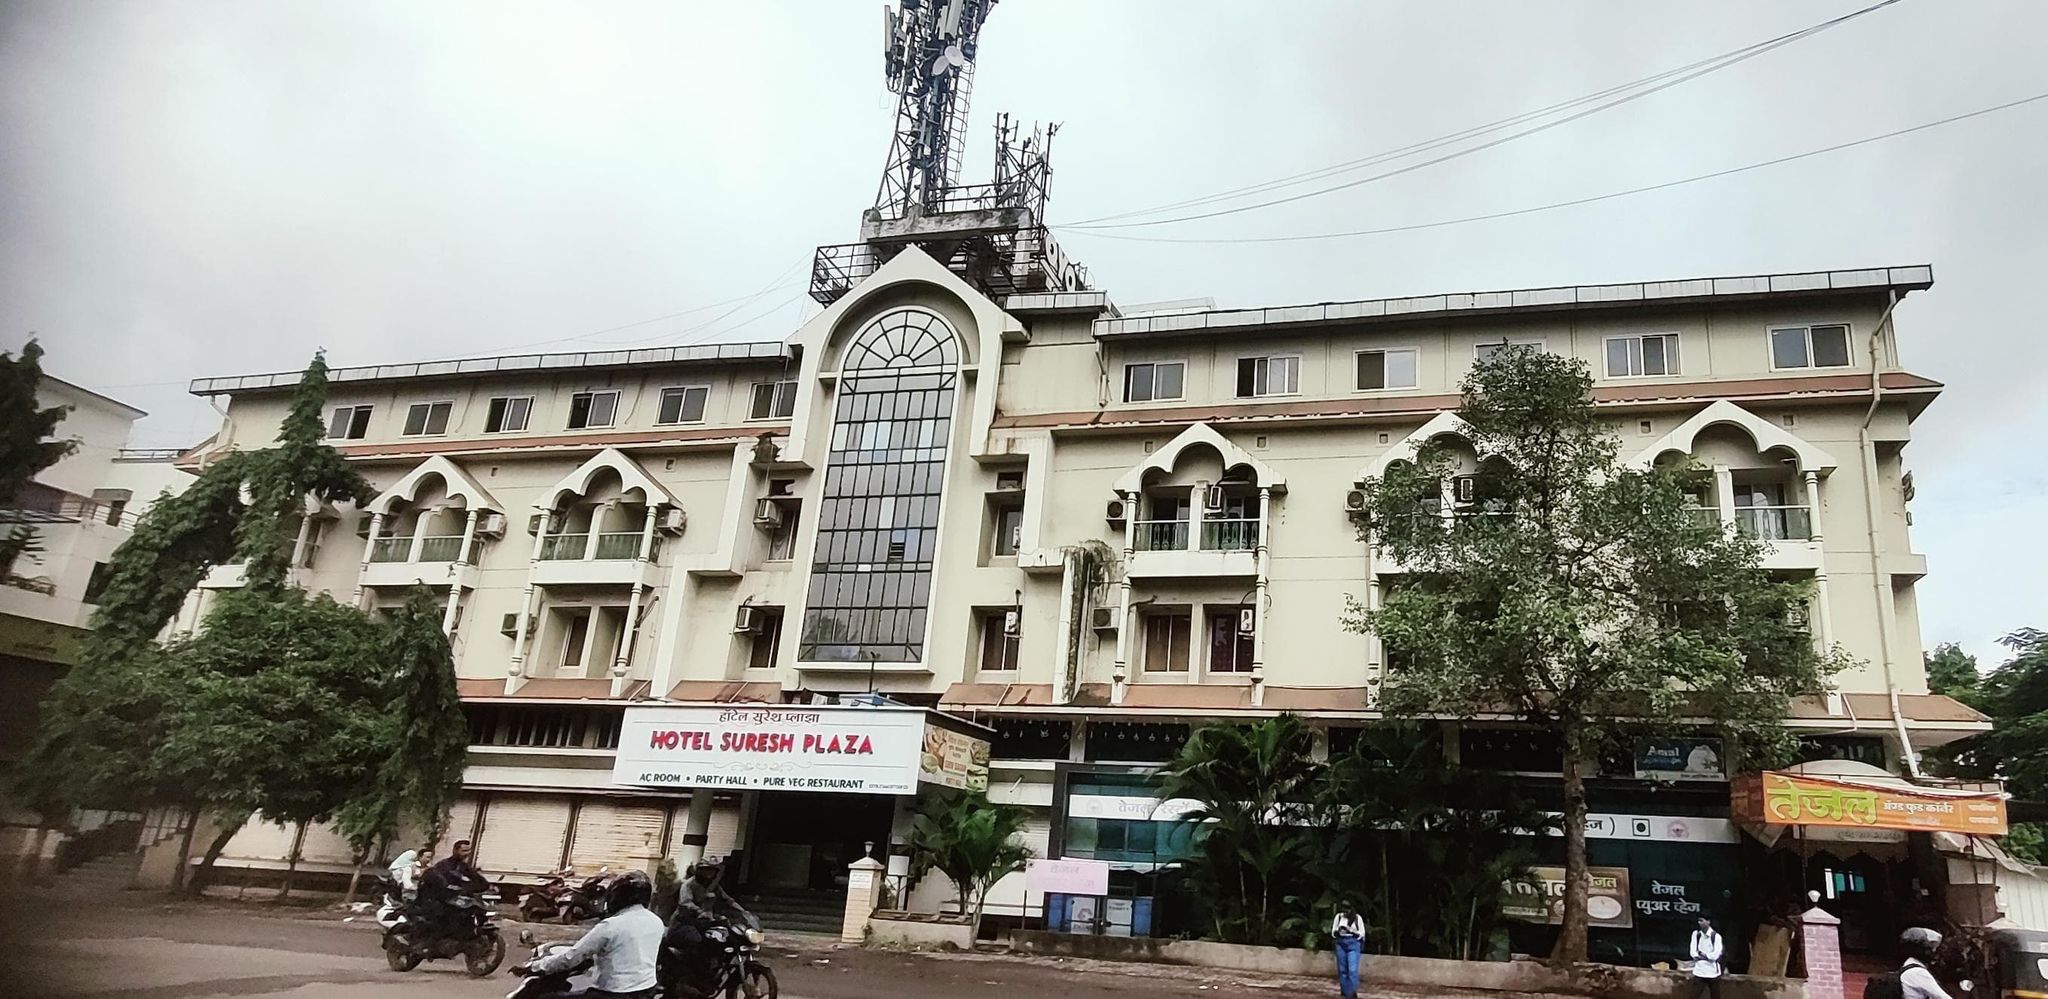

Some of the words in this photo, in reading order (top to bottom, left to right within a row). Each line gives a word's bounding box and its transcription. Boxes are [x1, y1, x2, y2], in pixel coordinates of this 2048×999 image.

[719, 708, 748, 722] हॉटेल
[753, 708, 782, 725] सुरेश
[786, 713, 820, 723] प्लाझा
[650, 730, 713, 751] HOTEL
[720, 732, 795, 753] SURESH
[802, 734, 874, 755] PLAZA
[639, 773, 652, 782] AC
[653, 774, 681, 782] ROOM
[695, 775, 724, 785] PARTY
[725, 776, 747, 785] HALL
[763, 777, 786, 787] PURE
[788, 778, 805, 787] VEG
[807, 778, 864, 789] RESTAURANT
[1767, 778, 1879, 824] तेजल
[1651, 880, 1685, 896] तेजल
[1636, 900, 1670, 914] प्युअर
